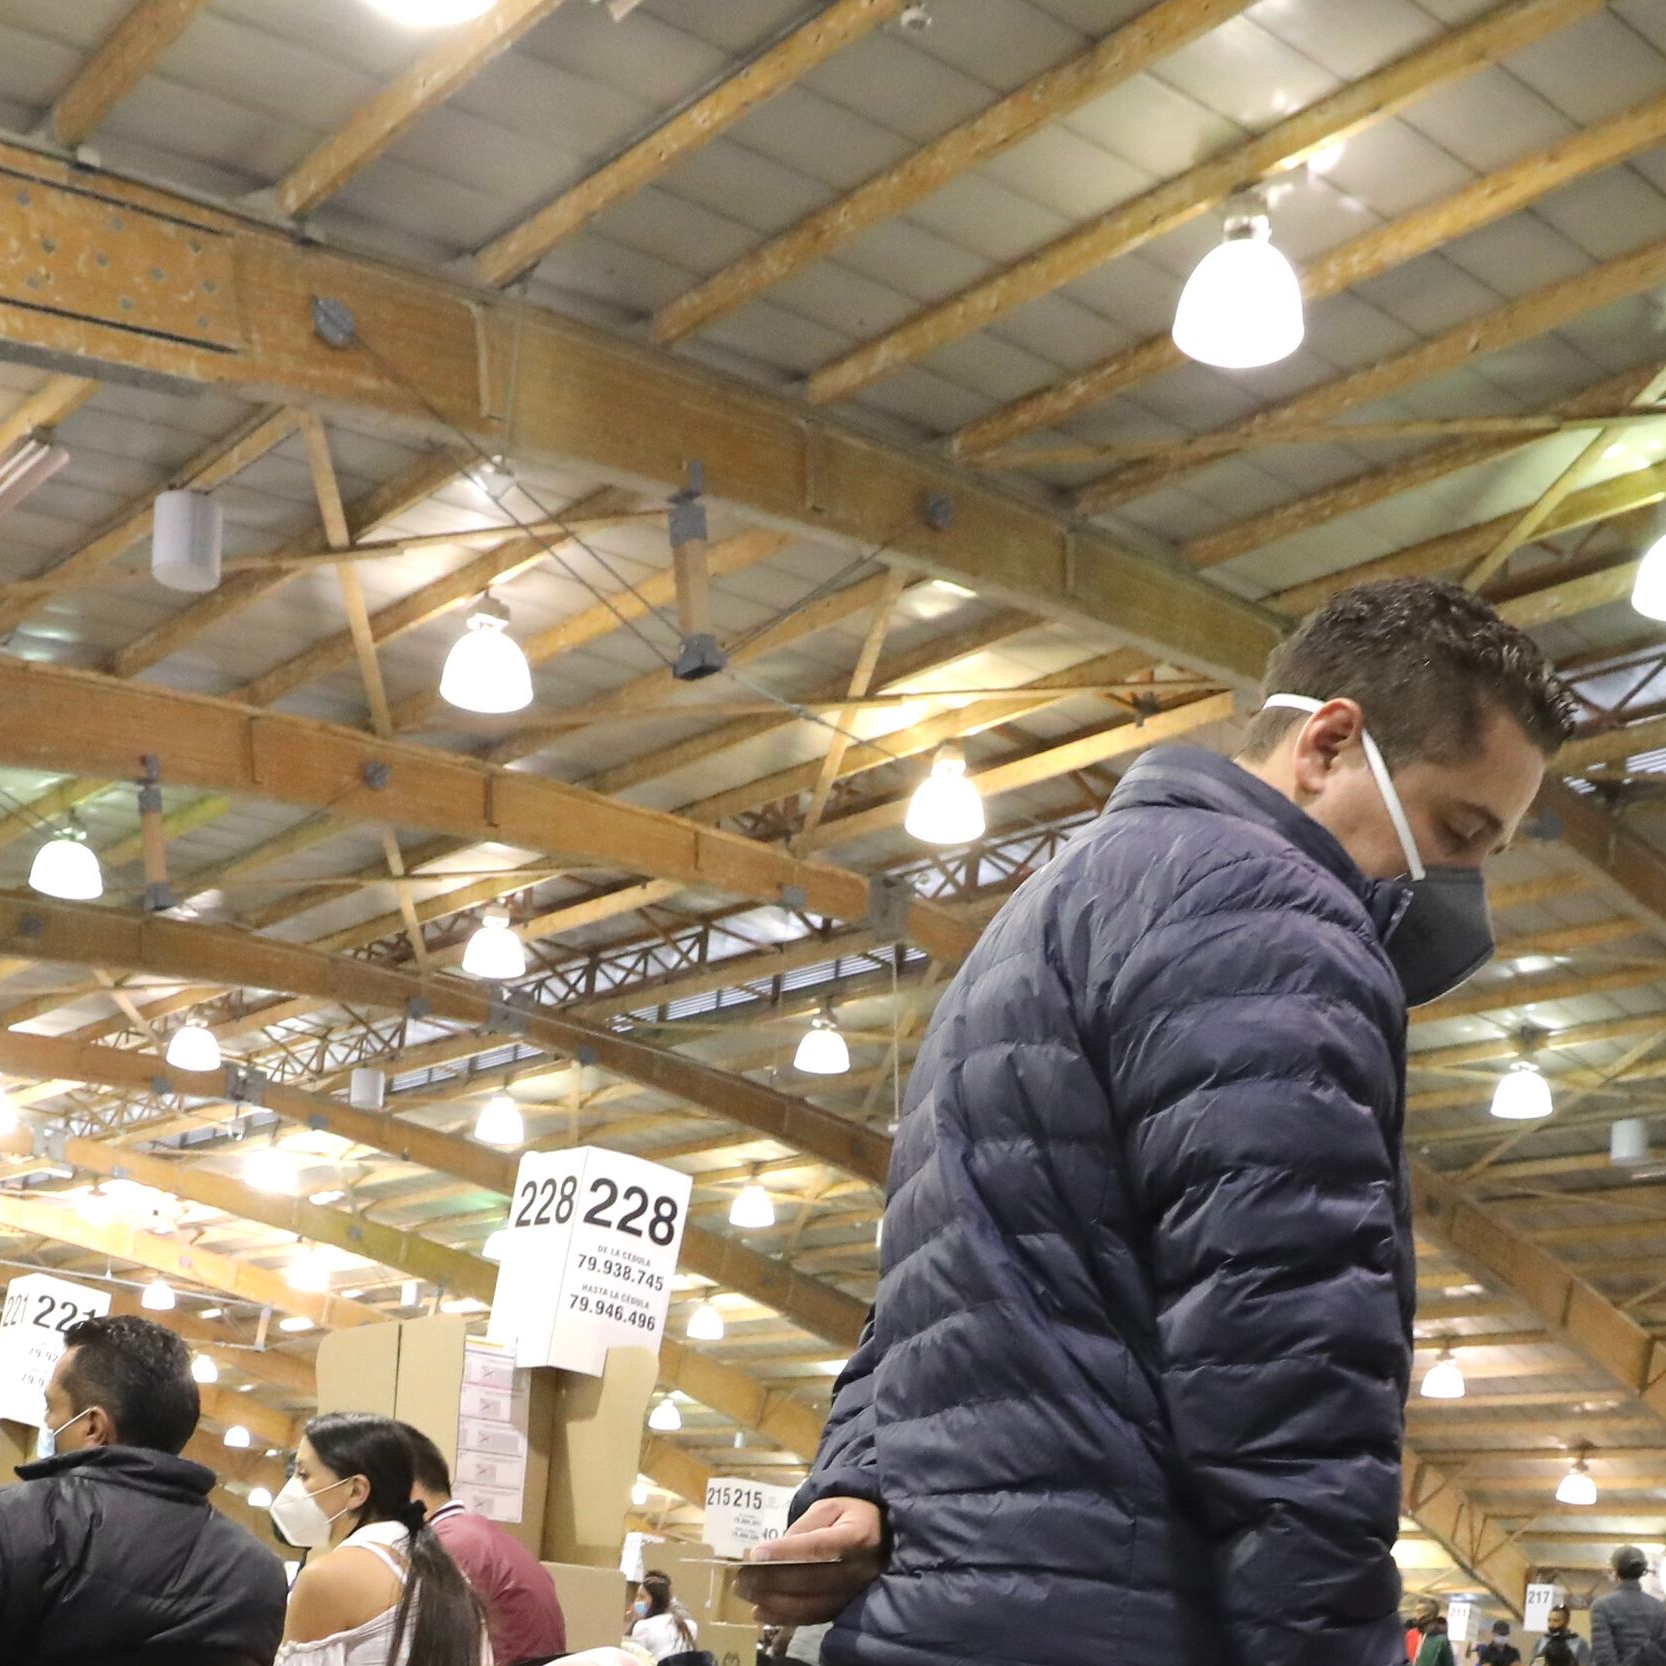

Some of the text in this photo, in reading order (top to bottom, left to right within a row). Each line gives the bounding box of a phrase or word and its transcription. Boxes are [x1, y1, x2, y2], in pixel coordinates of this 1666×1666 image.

[515, 1175, 578, 1228] 228
[583, 1178, 678, 1246] 228
[611, 1248, 621, 1257] LA
[577, 1254, 664, 1292] 79.938.745
[582, 1284, 608, 1296] HASTA
[609, 1290, 620, 1300] LA
[3, 1293, 29, 1328] 221
[569, 1294, 656, 1332] 79.946.496
[707, 1487, 731, 1506] 215
[733, 1488, 763, 1510] 215
[1528, 1590, 1550, 1604] 217
